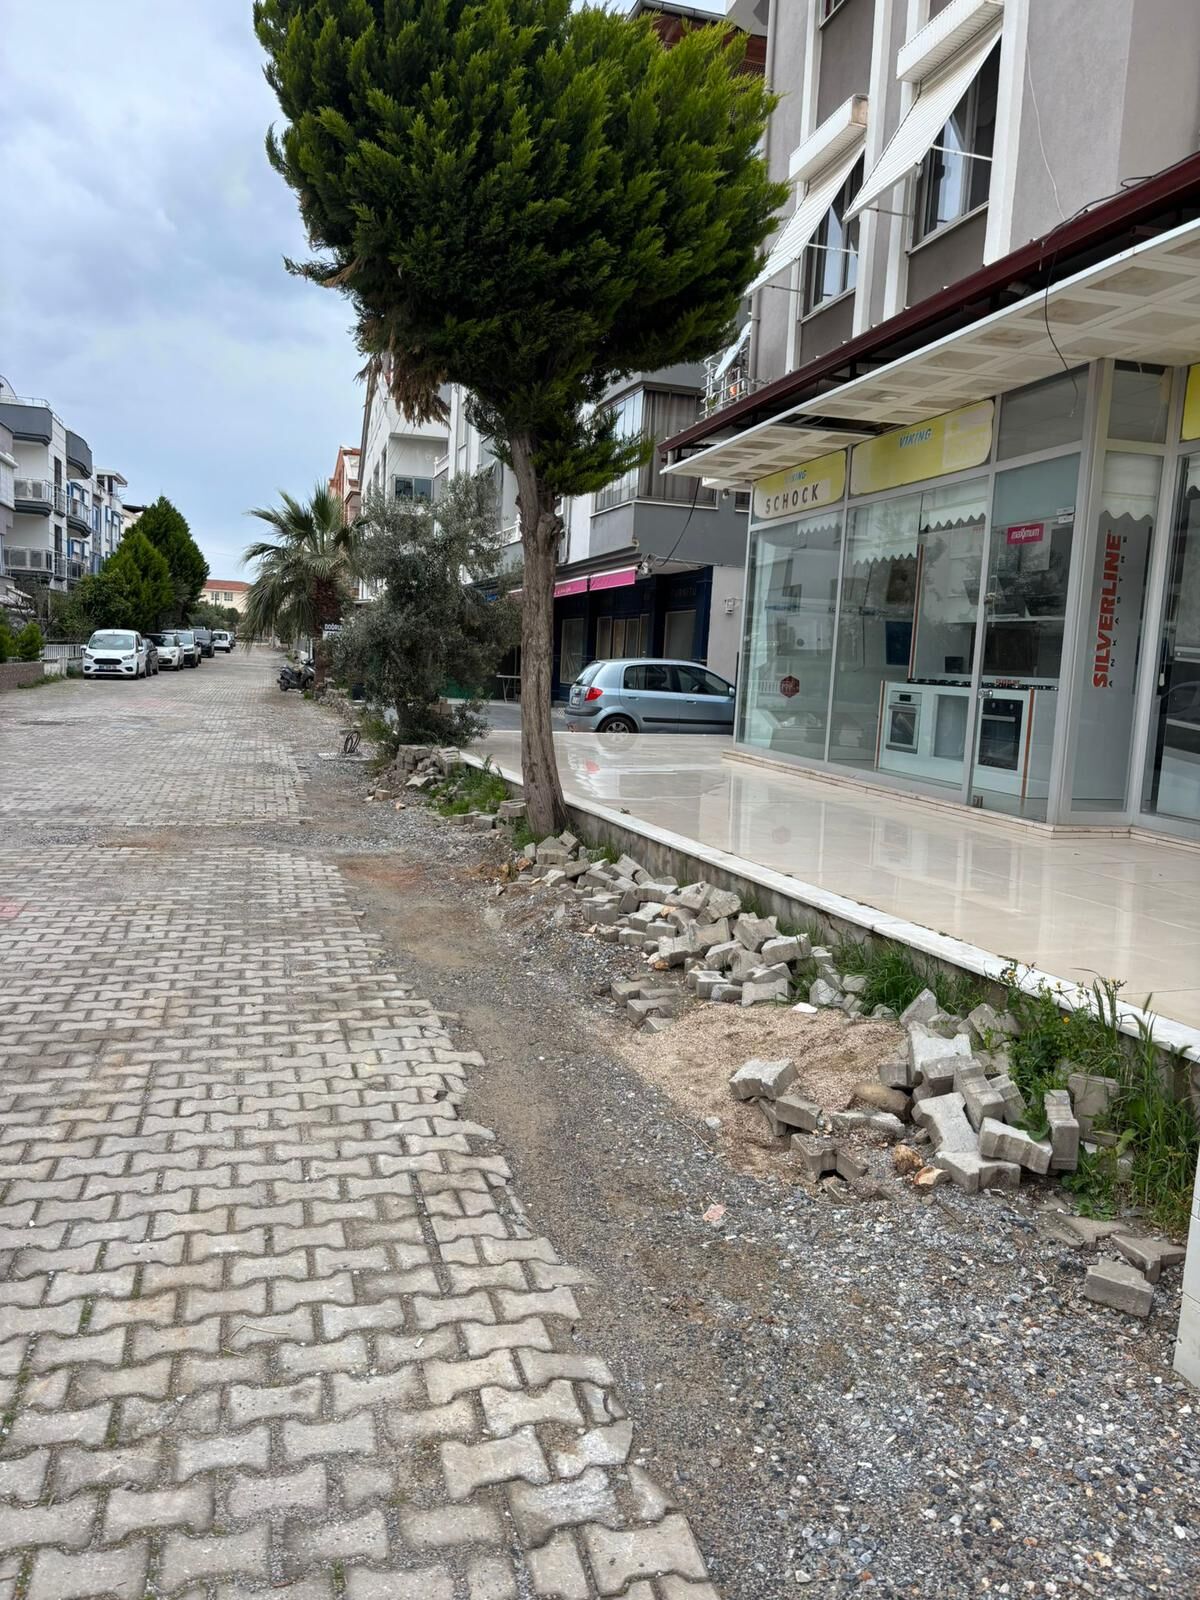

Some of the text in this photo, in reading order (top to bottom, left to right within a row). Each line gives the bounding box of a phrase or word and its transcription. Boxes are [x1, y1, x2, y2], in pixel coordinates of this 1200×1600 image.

[899, 429, 932, 448] VIKING
[765, 484, 819, 514] SCHOCK
[1093, 533, 1122, 689] SILVERLINE
